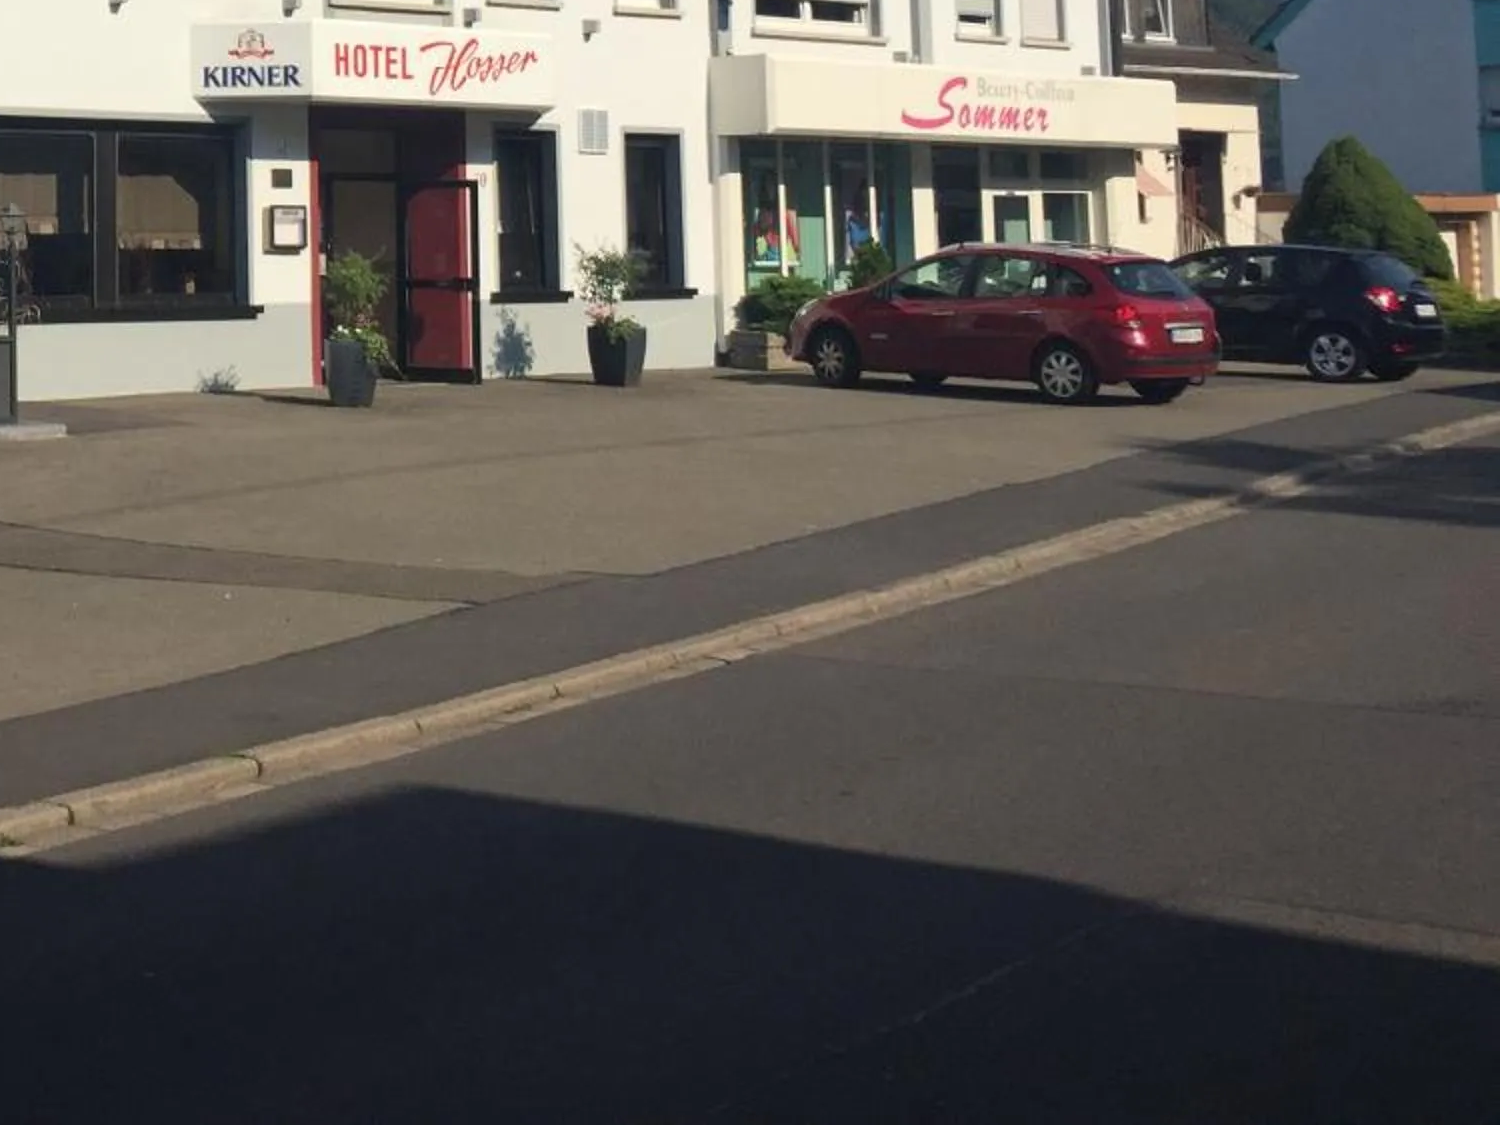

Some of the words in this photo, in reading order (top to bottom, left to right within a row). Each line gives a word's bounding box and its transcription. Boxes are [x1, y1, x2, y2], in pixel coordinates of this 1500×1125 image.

[203, 63, 302, 89] KIRNER
[334, 42, 415, 80] HOTEL
[900, 76, 1050, 132] Sommer
